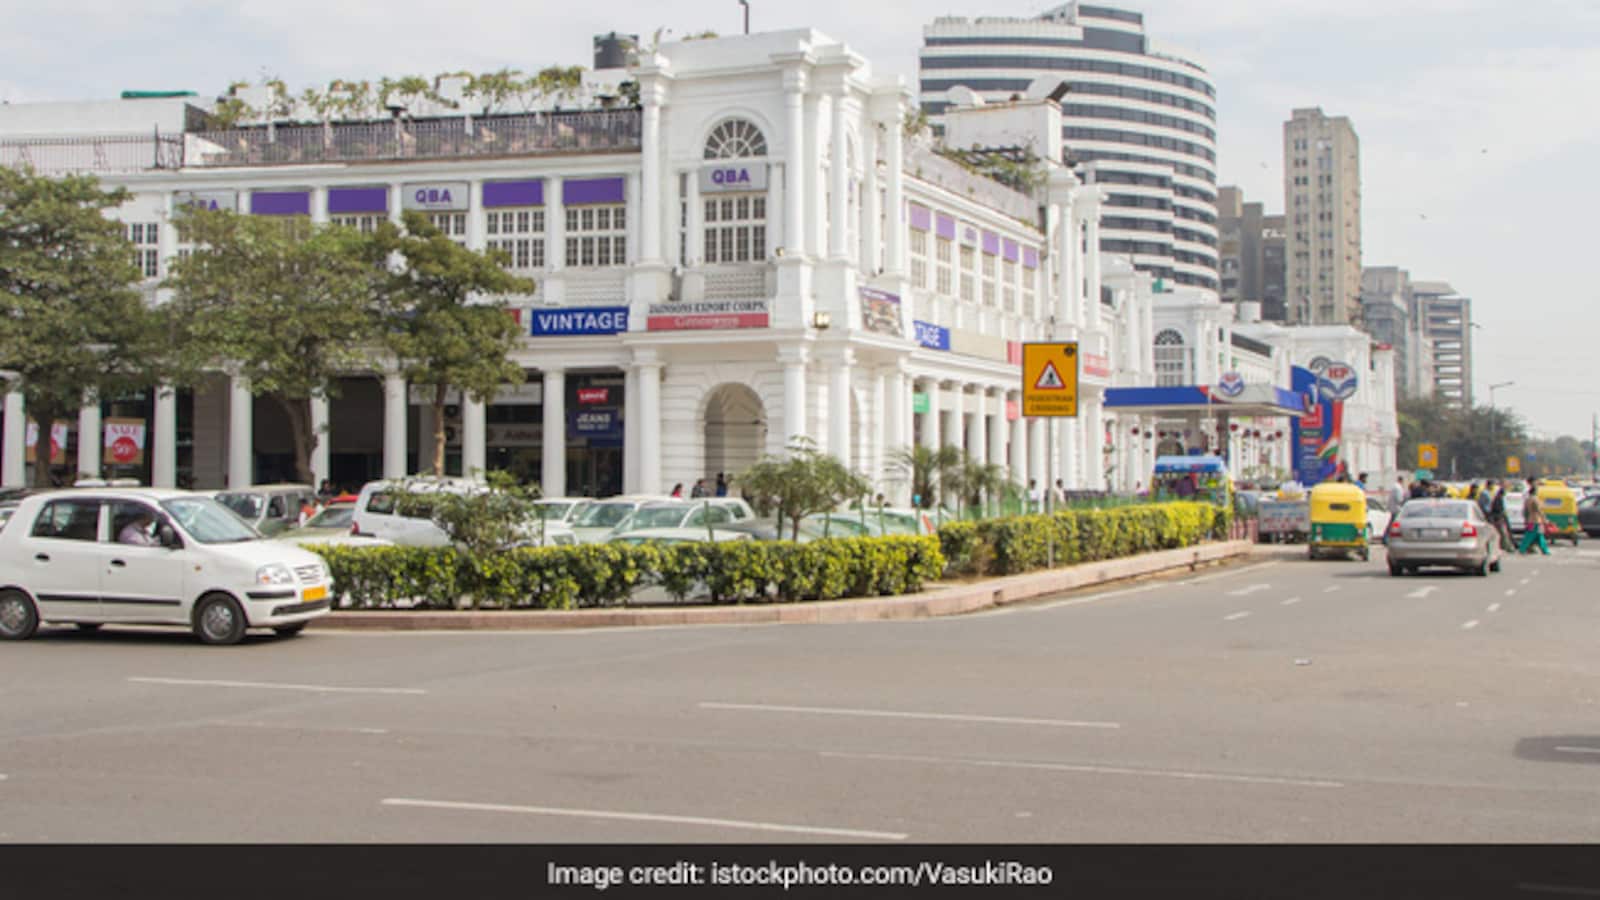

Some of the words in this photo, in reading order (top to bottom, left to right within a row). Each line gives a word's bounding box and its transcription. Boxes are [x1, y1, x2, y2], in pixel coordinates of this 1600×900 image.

[712, 168, 750, 184] QBA
[415, 189, 452, 203] QBA
[538, 312, 626, 330] VINTAGE
